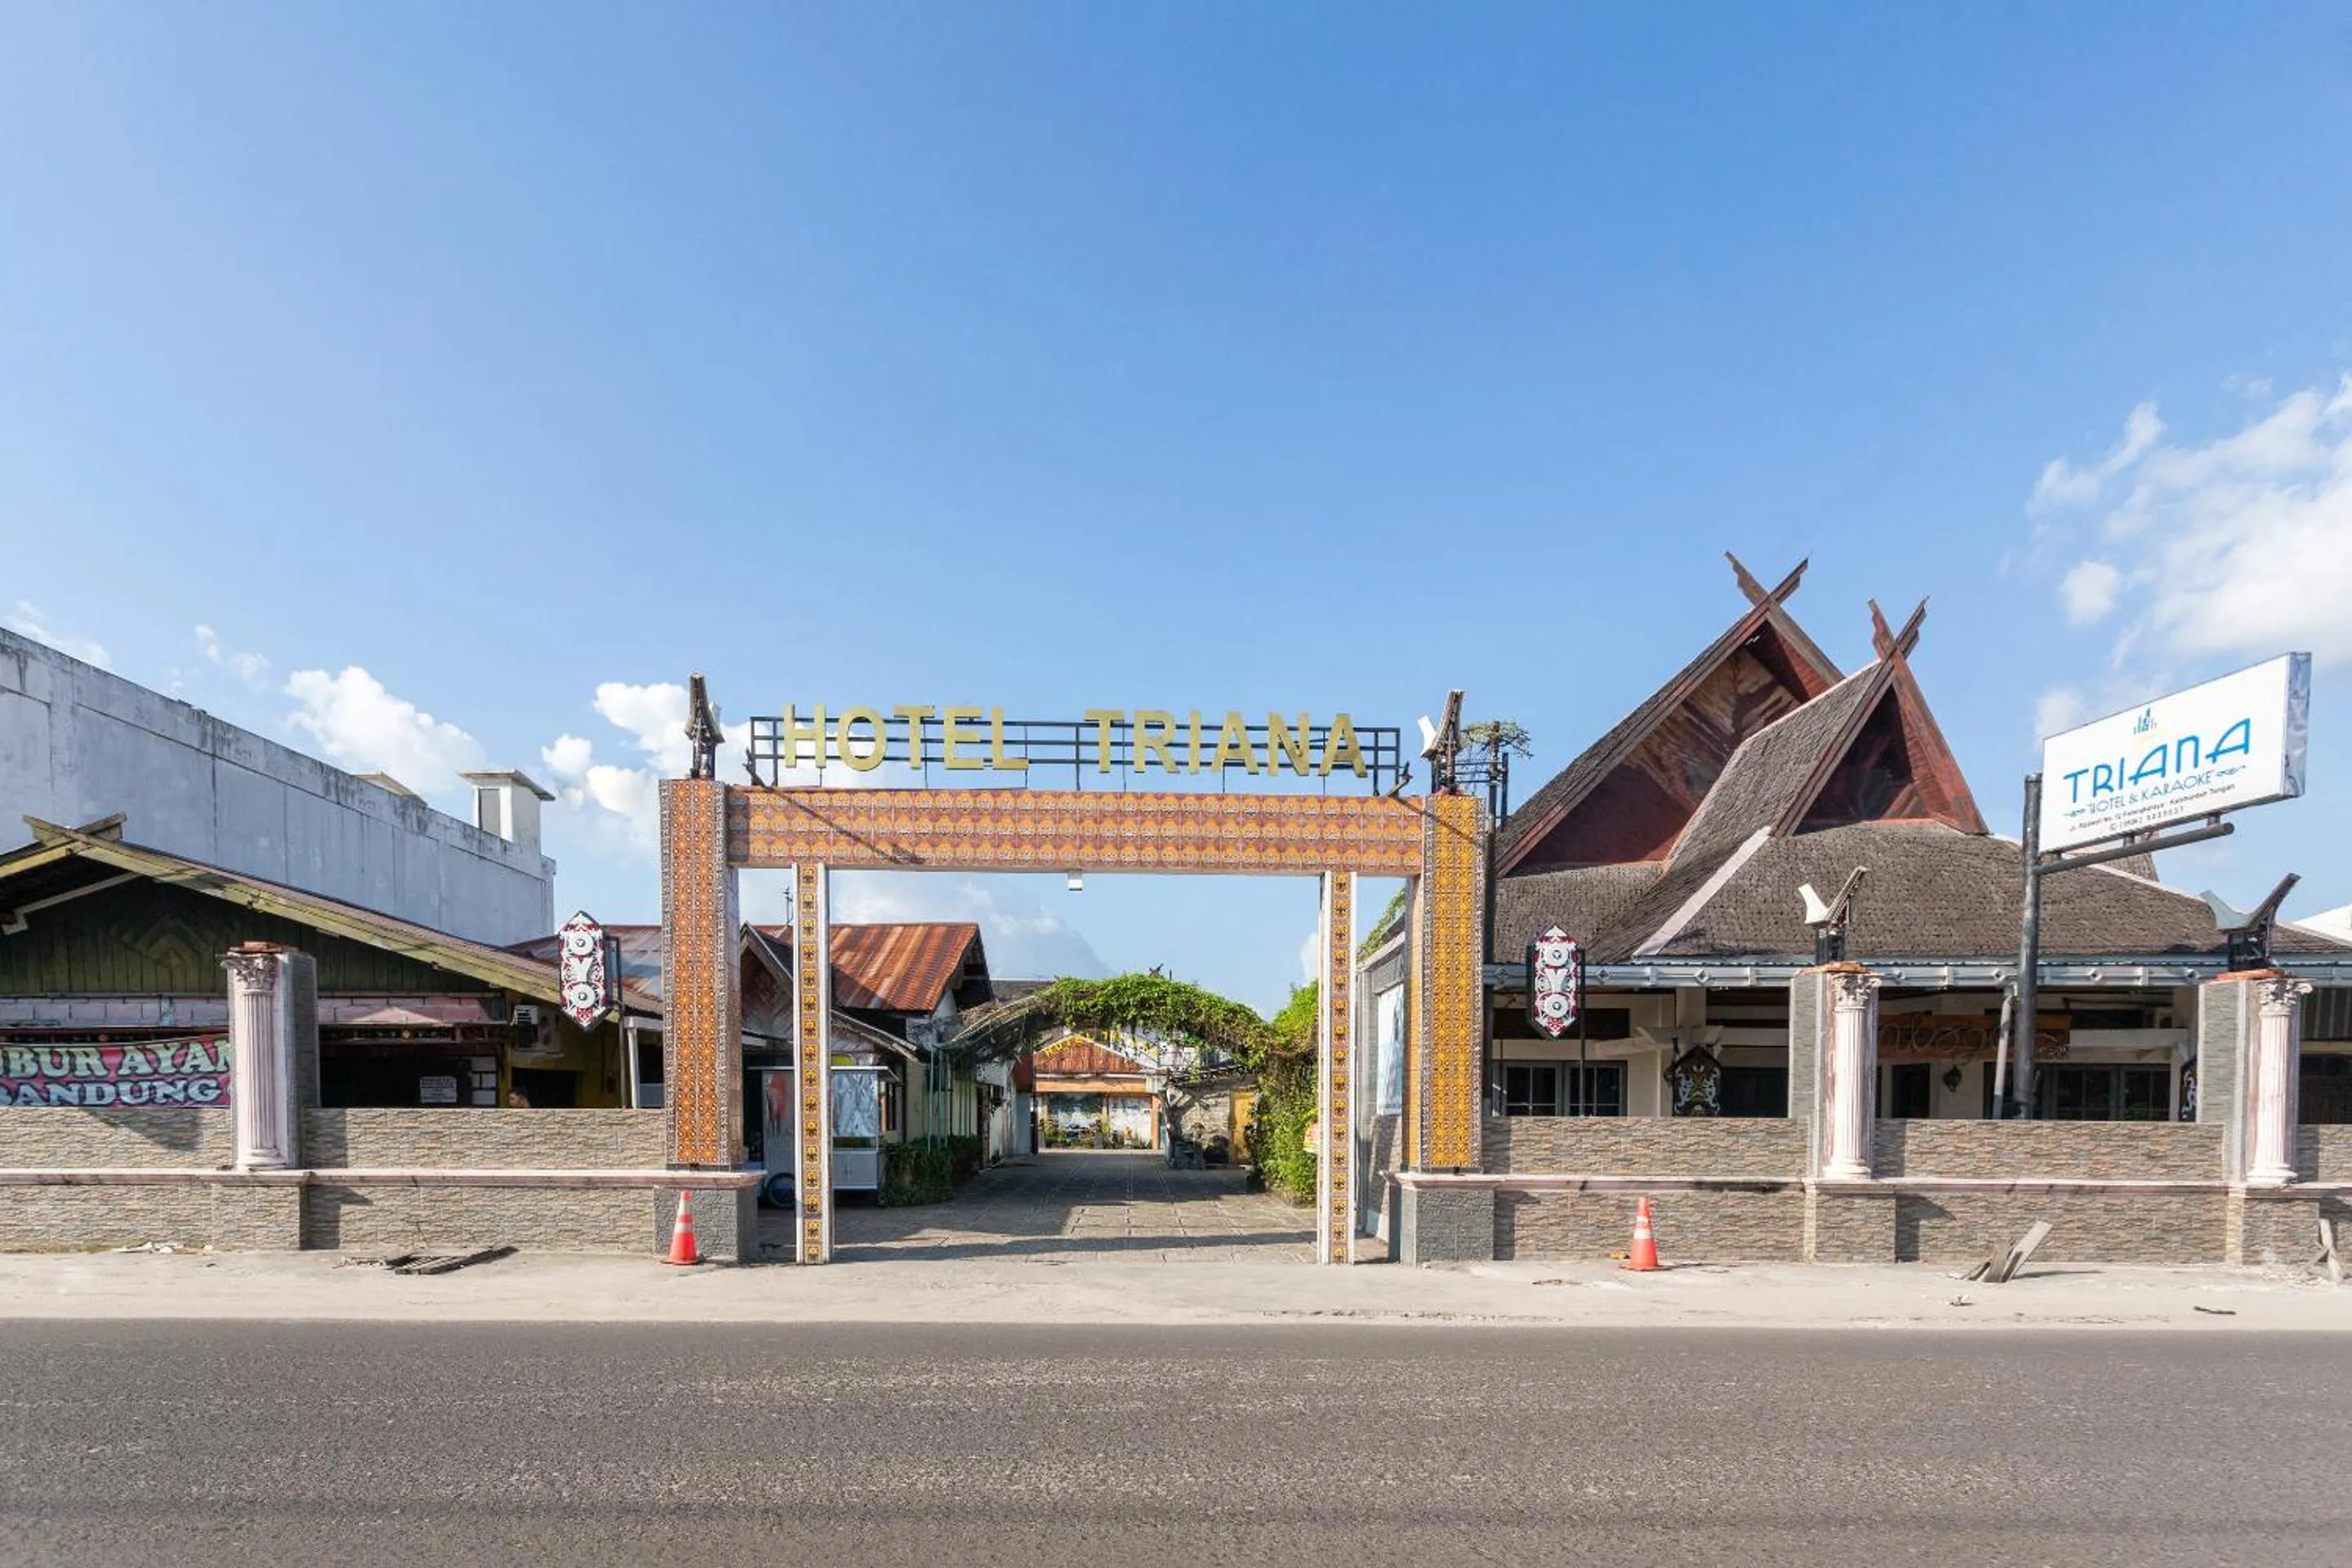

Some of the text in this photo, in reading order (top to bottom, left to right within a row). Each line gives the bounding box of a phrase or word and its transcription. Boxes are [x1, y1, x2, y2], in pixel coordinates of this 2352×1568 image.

[782, 703, 1368, 777] HOTEL TRIANA
[2086, 769, 2215, 814] HOTEL & KARAOKE
[0, 1046, 109, 1079] BUR
